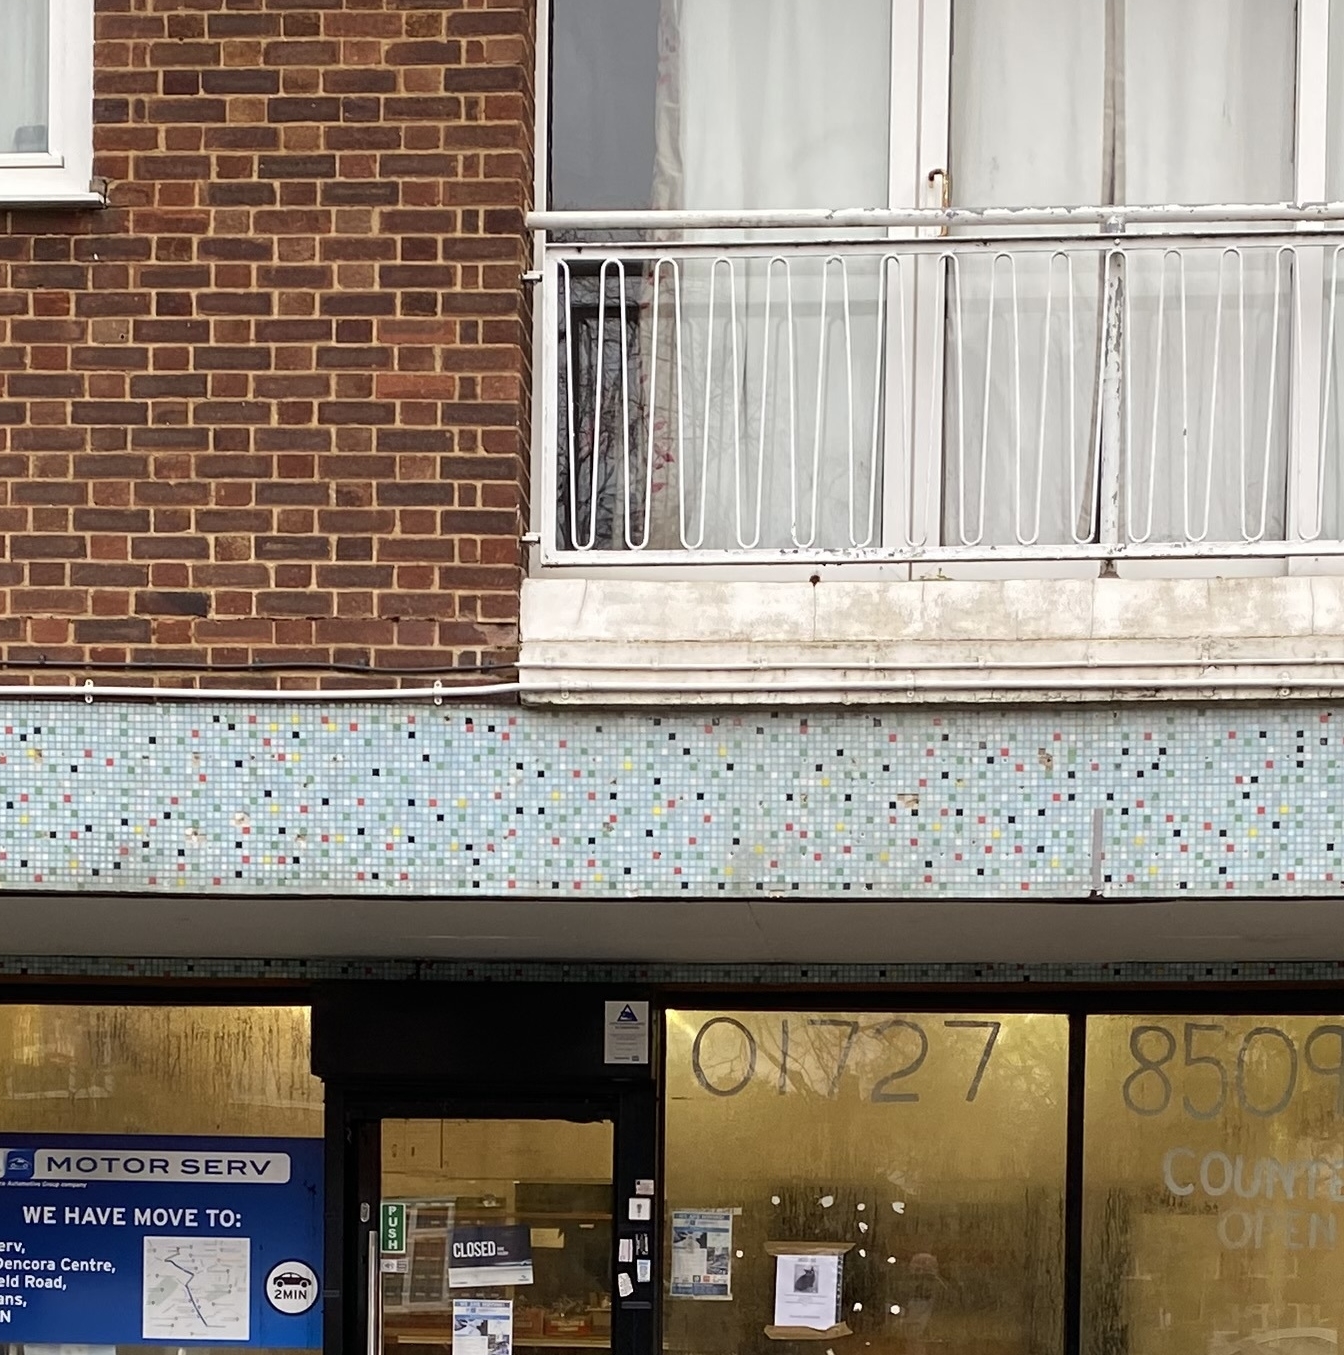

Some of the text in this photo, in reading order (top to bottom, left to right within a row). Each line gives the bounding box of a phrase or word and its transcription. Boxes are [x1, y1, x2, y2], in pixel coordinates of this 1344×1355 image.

[692, 1016, 1002, 1102] 01727
[47, 1155, 170, 1175] MOTOR
[180, 1158, 271, 1176] SERV
[22, 1206, 242, 1228] WE HAVE MOVE TO:
[387, 1205, 399, 1250] PUSH
[1216, 1208, 1338, 1250] OPEN
[453, 1241, 497, 1258] CLOSED
[60, 1258, 116, 1274] Centre,
[24, 1275, 67, 1291] Road,
[274, 1289, 307, 1300] 2MIN
